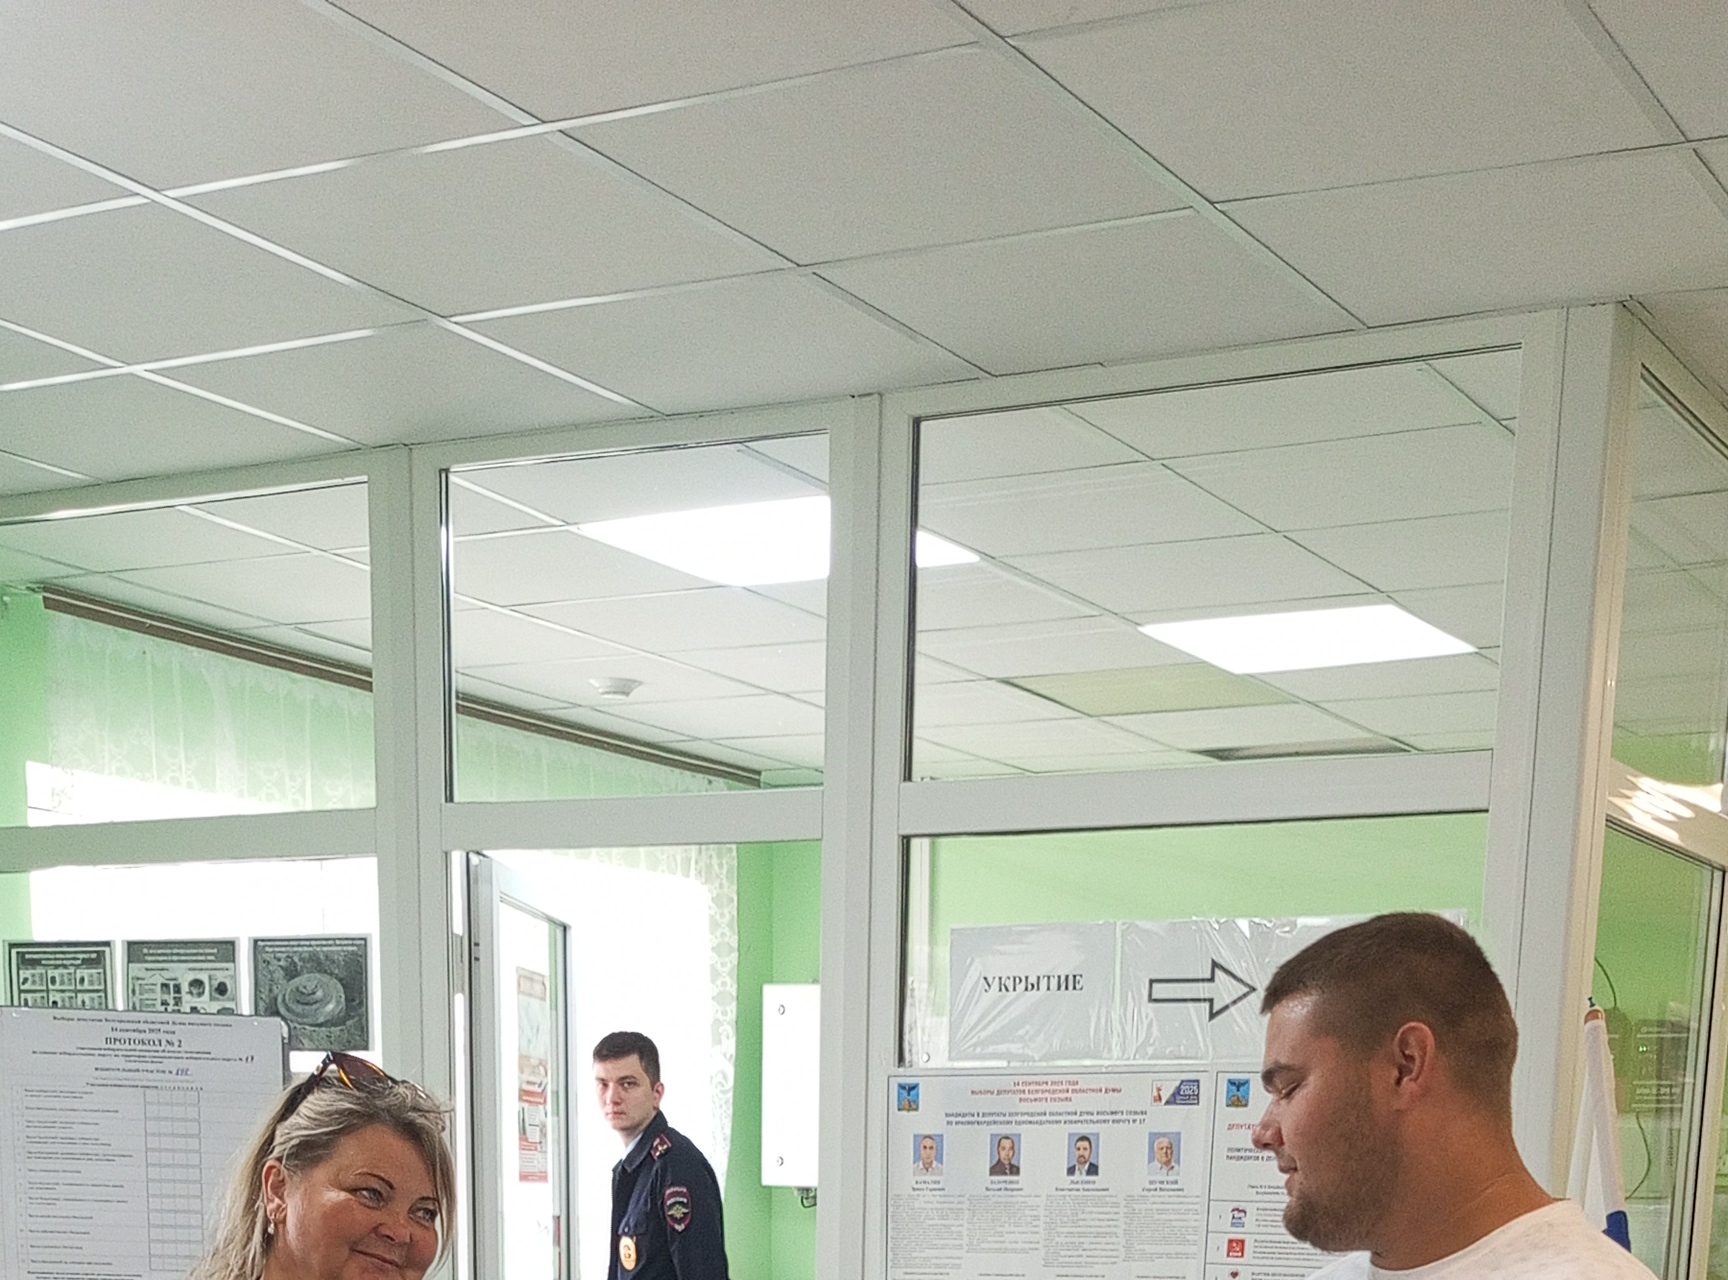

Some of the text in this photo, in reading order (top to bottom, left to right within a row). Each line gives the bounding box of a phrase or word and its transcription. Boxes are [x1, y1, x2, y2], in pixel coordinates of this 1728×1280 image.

[982, 973, 1084, 993] УКРЫТИЕ
[104, 1037, 183, 1048] ПРОТОКОЛ № 2
[996, 1088, 1026, 1096] ДЕПУТАТОВ
[1071, 1087, 1103, 1095] ОБЛАСТНОЙ
[1104, 1087, 1122, 1095] ДУМЫ
[1180, 1085, 1199, 1095] 2025
